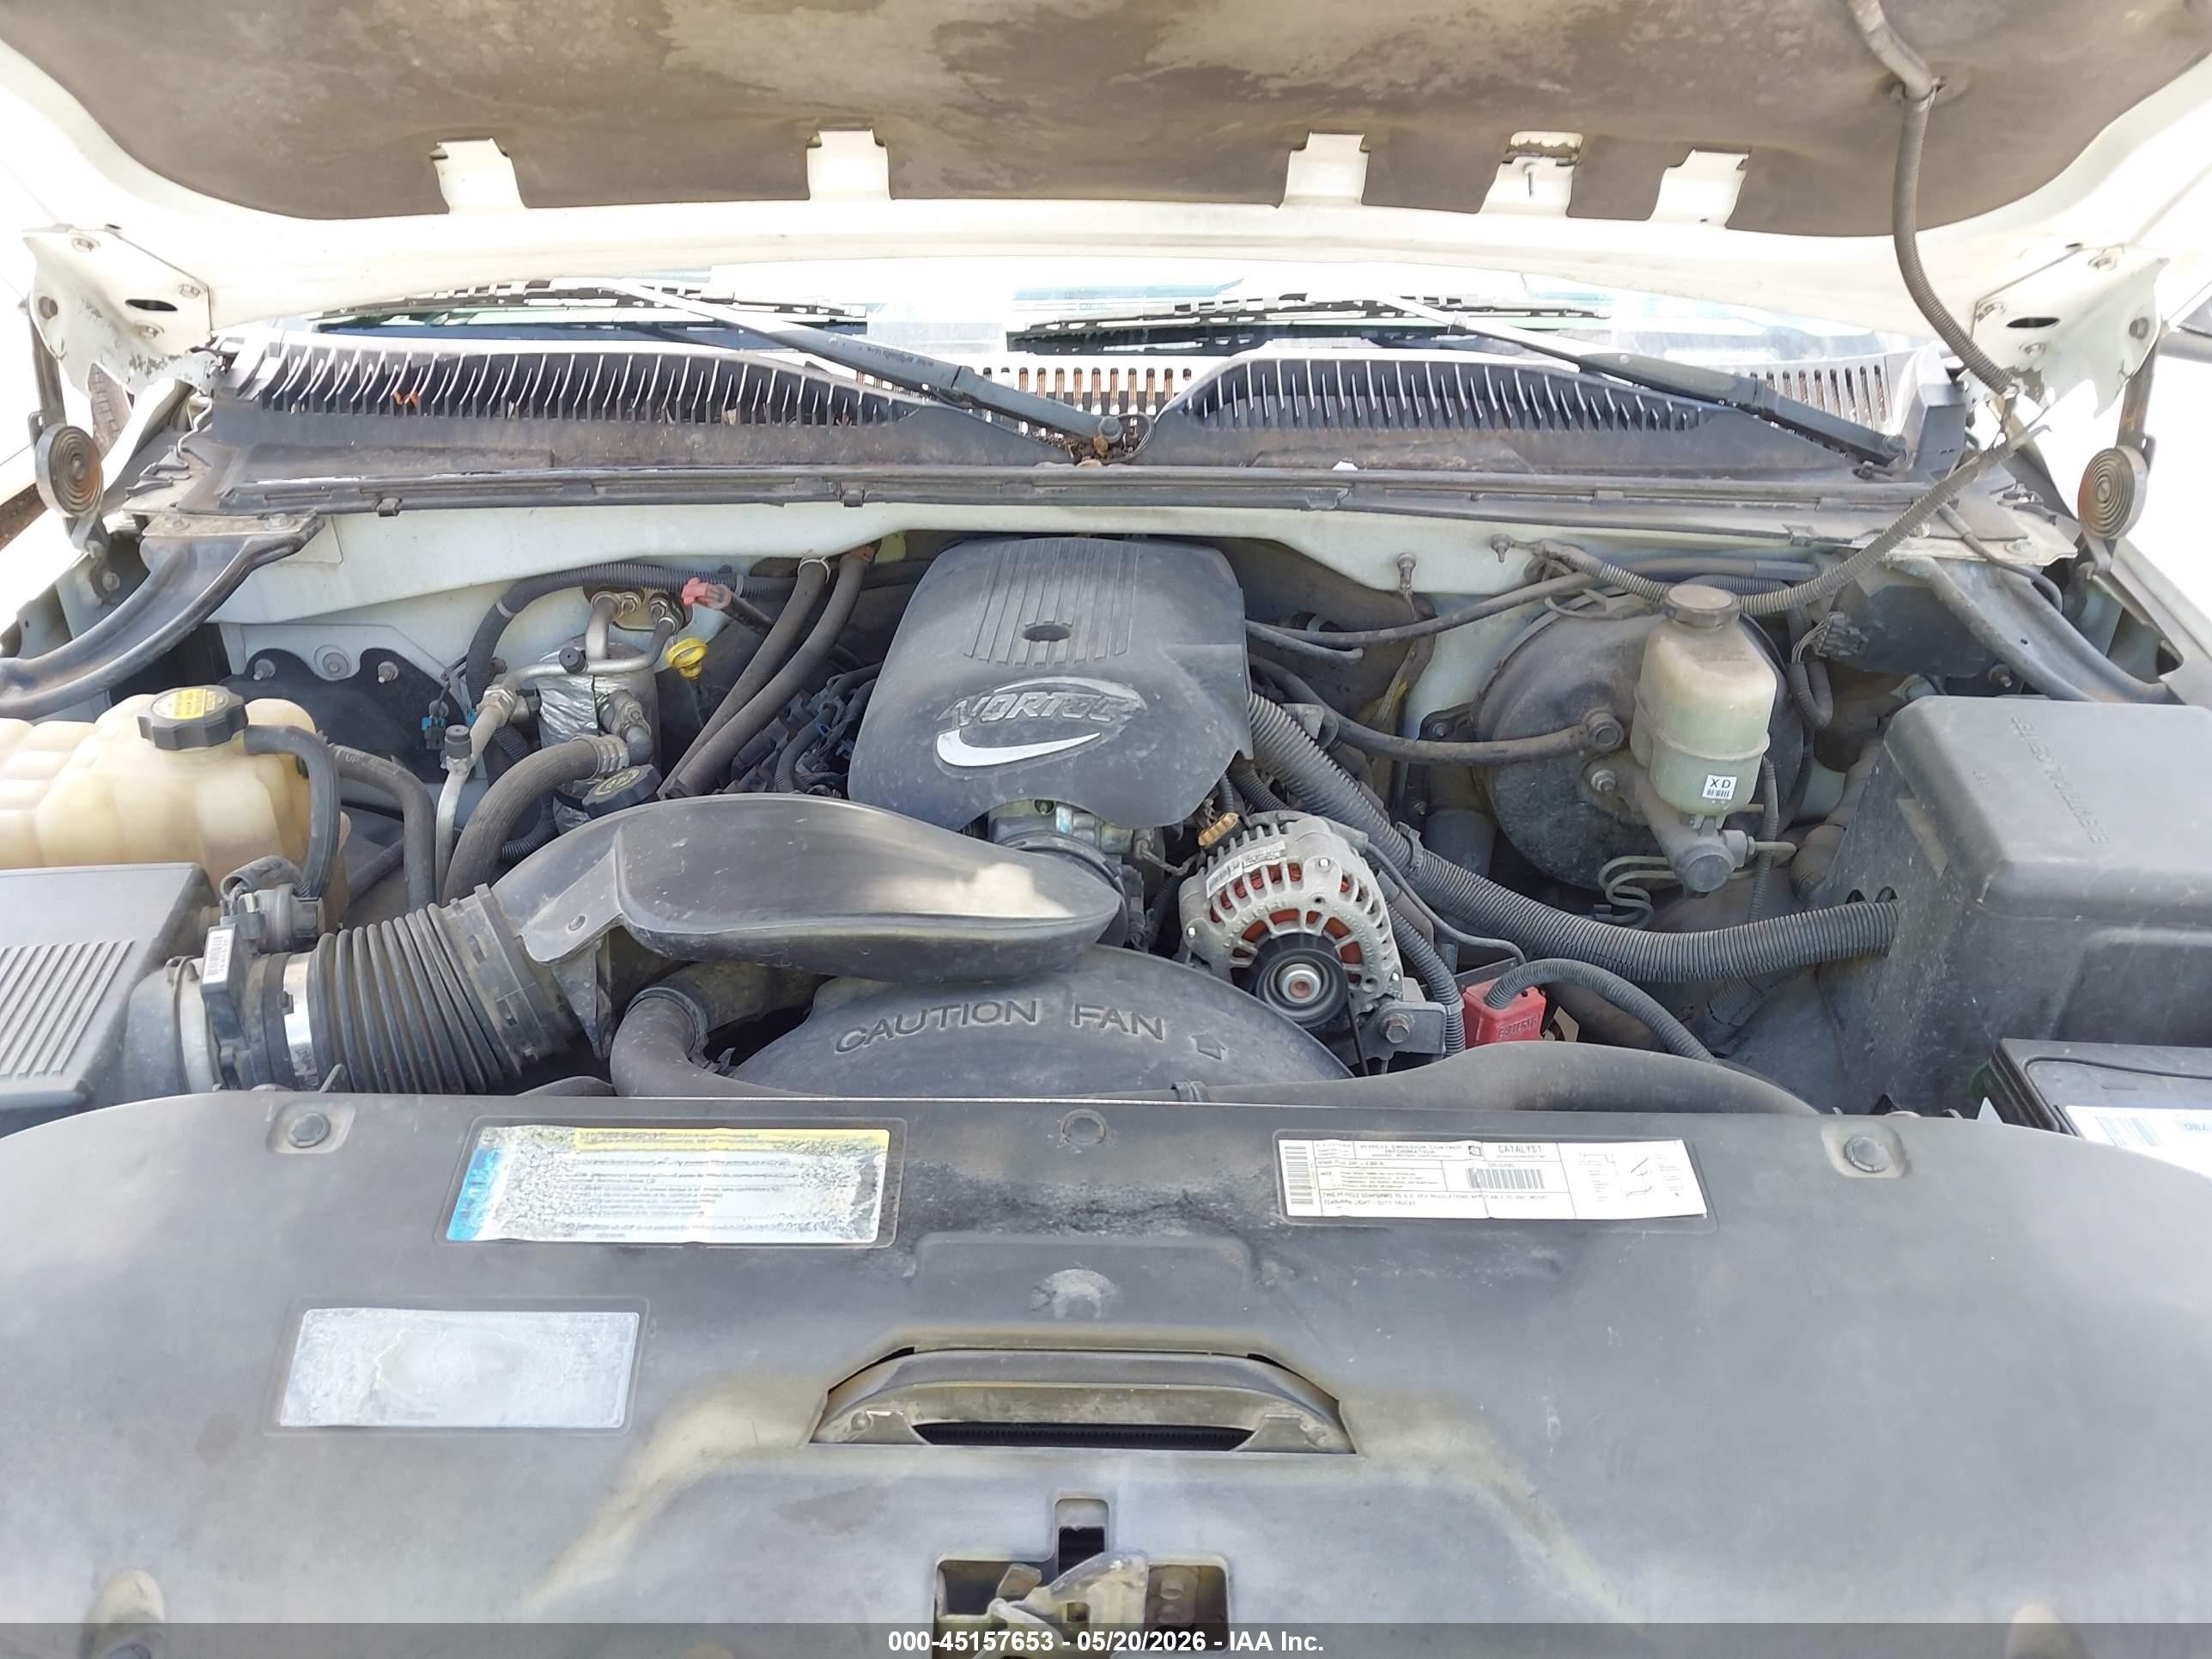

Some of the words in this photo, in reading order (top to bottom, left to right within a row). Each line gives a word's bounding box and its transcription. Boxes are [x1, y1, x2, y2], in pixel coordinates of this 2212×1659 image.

[834, 999, 1037, 1054] CAUTION
[1073, 1002, 1165, 1041] FAN
[1498, 1145, 1542, 1154] CATALYST
